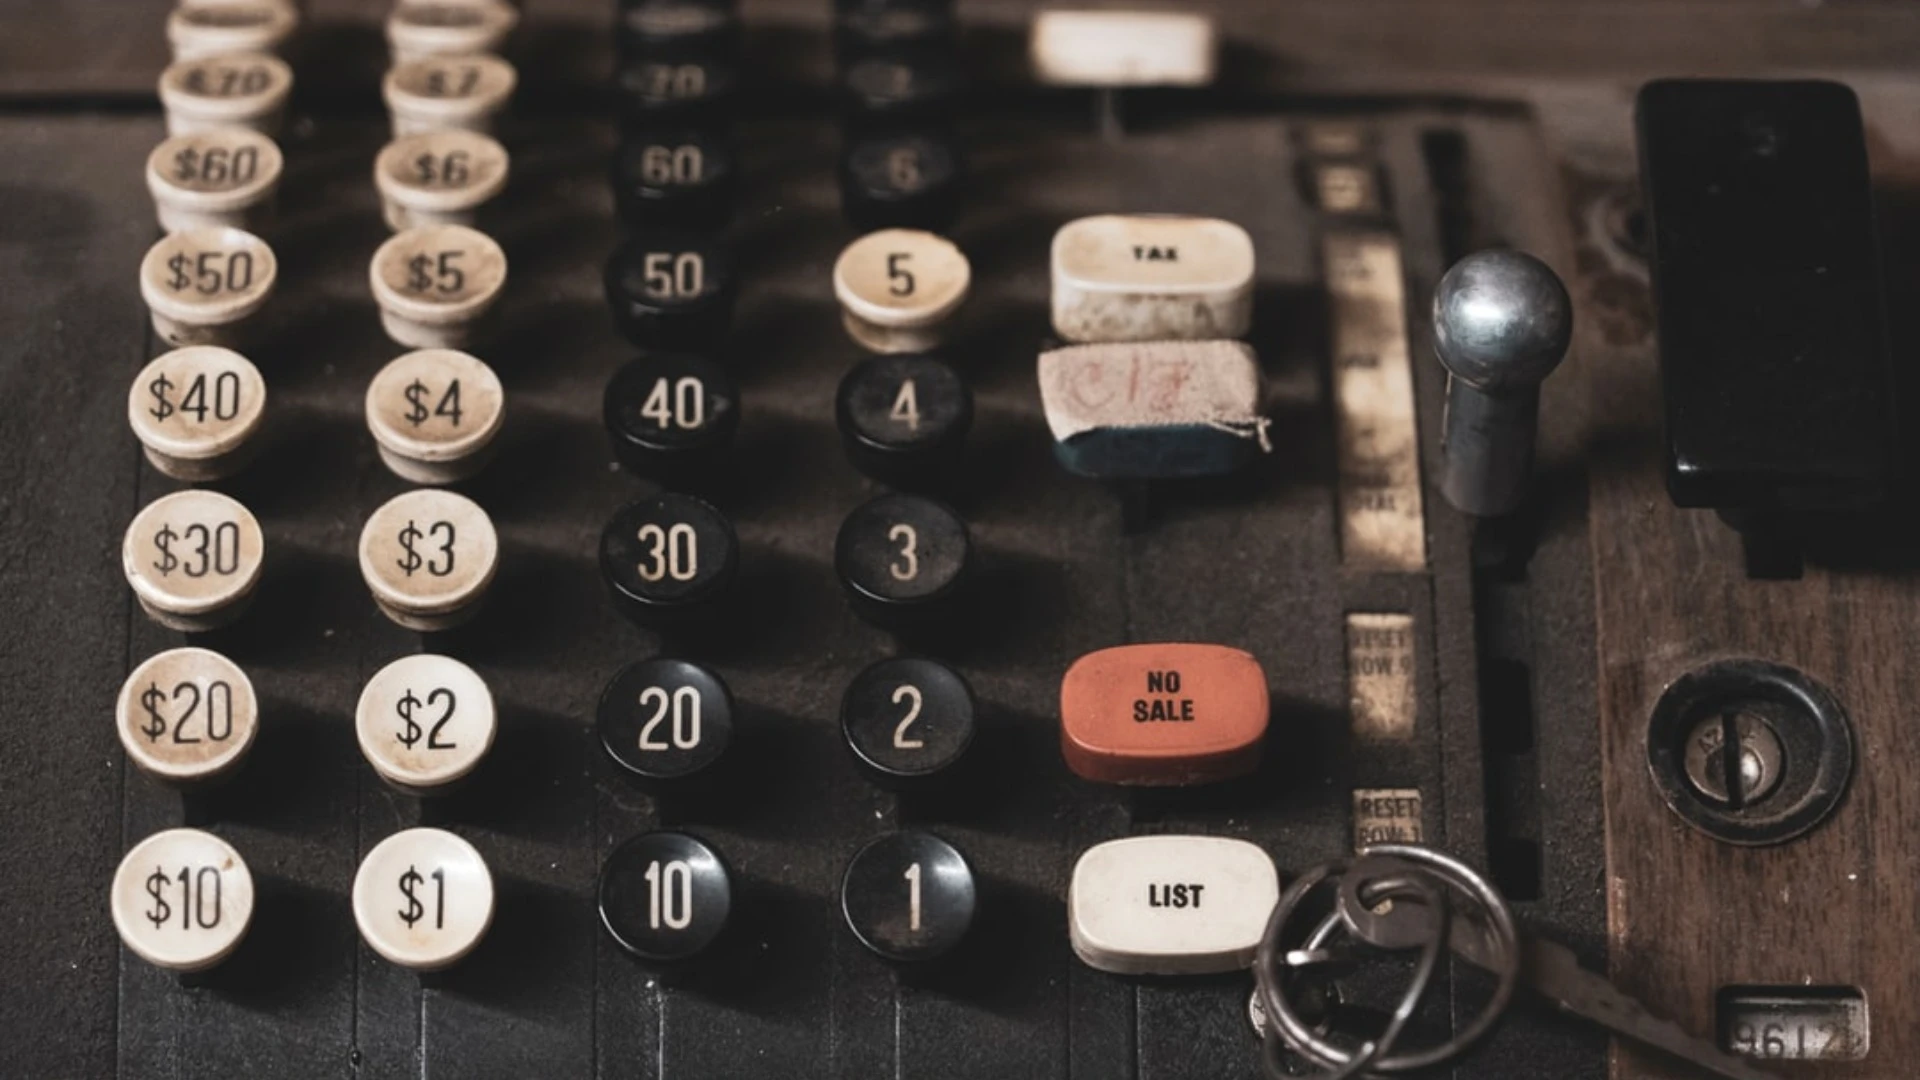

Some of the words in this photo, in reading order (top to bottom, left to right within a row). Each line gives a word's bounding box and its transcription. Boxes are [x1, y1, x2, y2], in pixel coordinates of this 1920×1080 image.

[172, 146, 259, 185] $60
[414, 150, 472, 187] $6
[642, 145, 703, 185] 60
[166, 250, 254, 297] $50
[406, 250, 466, 297] $5
[644, 252, 704, 299] 50
[885, 252, 916, 297] 5
[1132, 245, 1180, 263] TAX
[149, 371, 242, 424] $40
[403, 377, 464, 427] $4
[640, 376, 704, 431] 40
[889, 379, 920, 432] 4
[152, 520, 241, 578] $30
[396, 520, 457, 578] $3
[637, 523, 698, 582] 30
[888, 524, 919, 582] 3
[1147, 671, 1181, 692] NO
[140, 680, 233, 744] $20
[396, 687, 457, 750] $2
[638, 685, 702, 751] 20
[891, 684, 924, 749] 2
[1133, 699, 1195, 722] SALE
[1359, 797, 1417, 819] RESET
[145, 866, 223, 930] $10
[397, 864, 446, 930] $1
[644, 860, 693, 930] 10
[904, 862, 922, 932] 1
[1149, 883, 1205, 908] LIST
